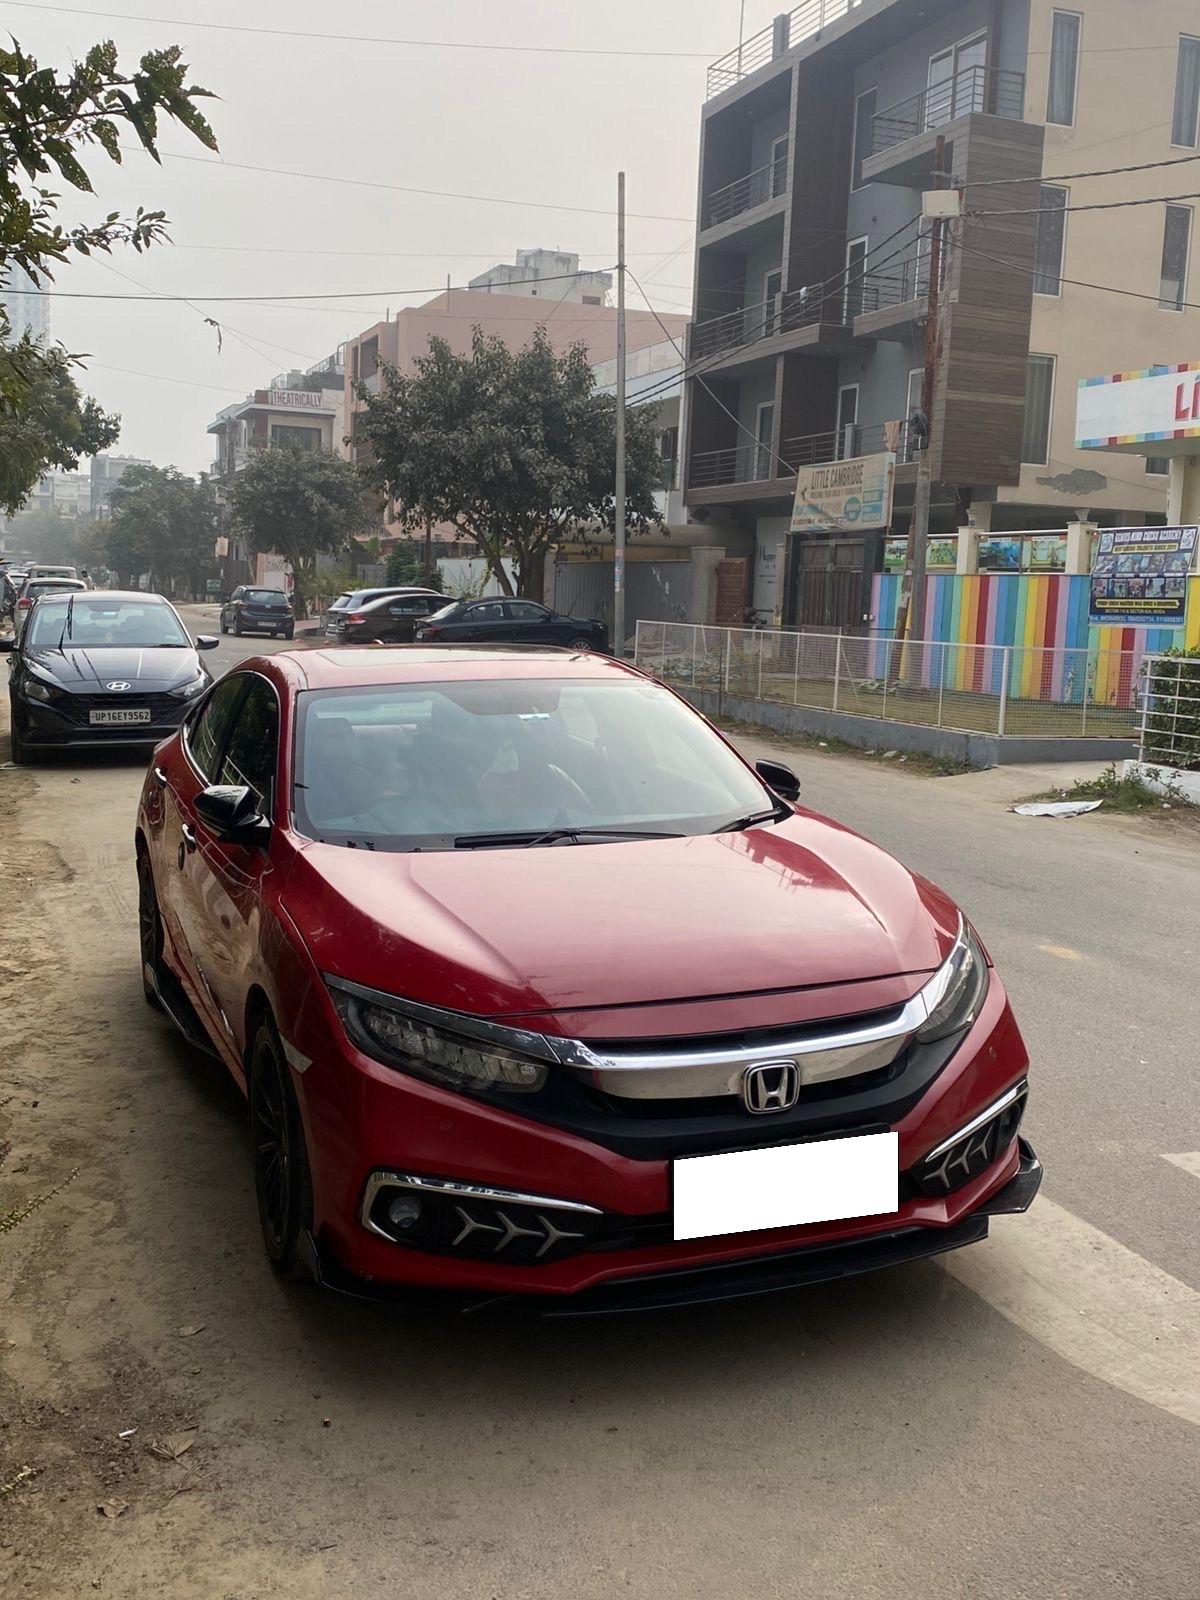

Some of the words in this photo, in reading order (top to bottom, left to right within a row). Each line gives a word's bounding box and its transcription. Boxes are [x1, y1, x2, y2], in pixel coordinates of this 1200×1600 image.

[272, 391, 322, 407] THEATRICALLY
[811, 470, 830, 490] LITTLE
[830, 464, 863, 487] CAMBRIDGE
[95, 711, 150, 721] UP16EY9562
